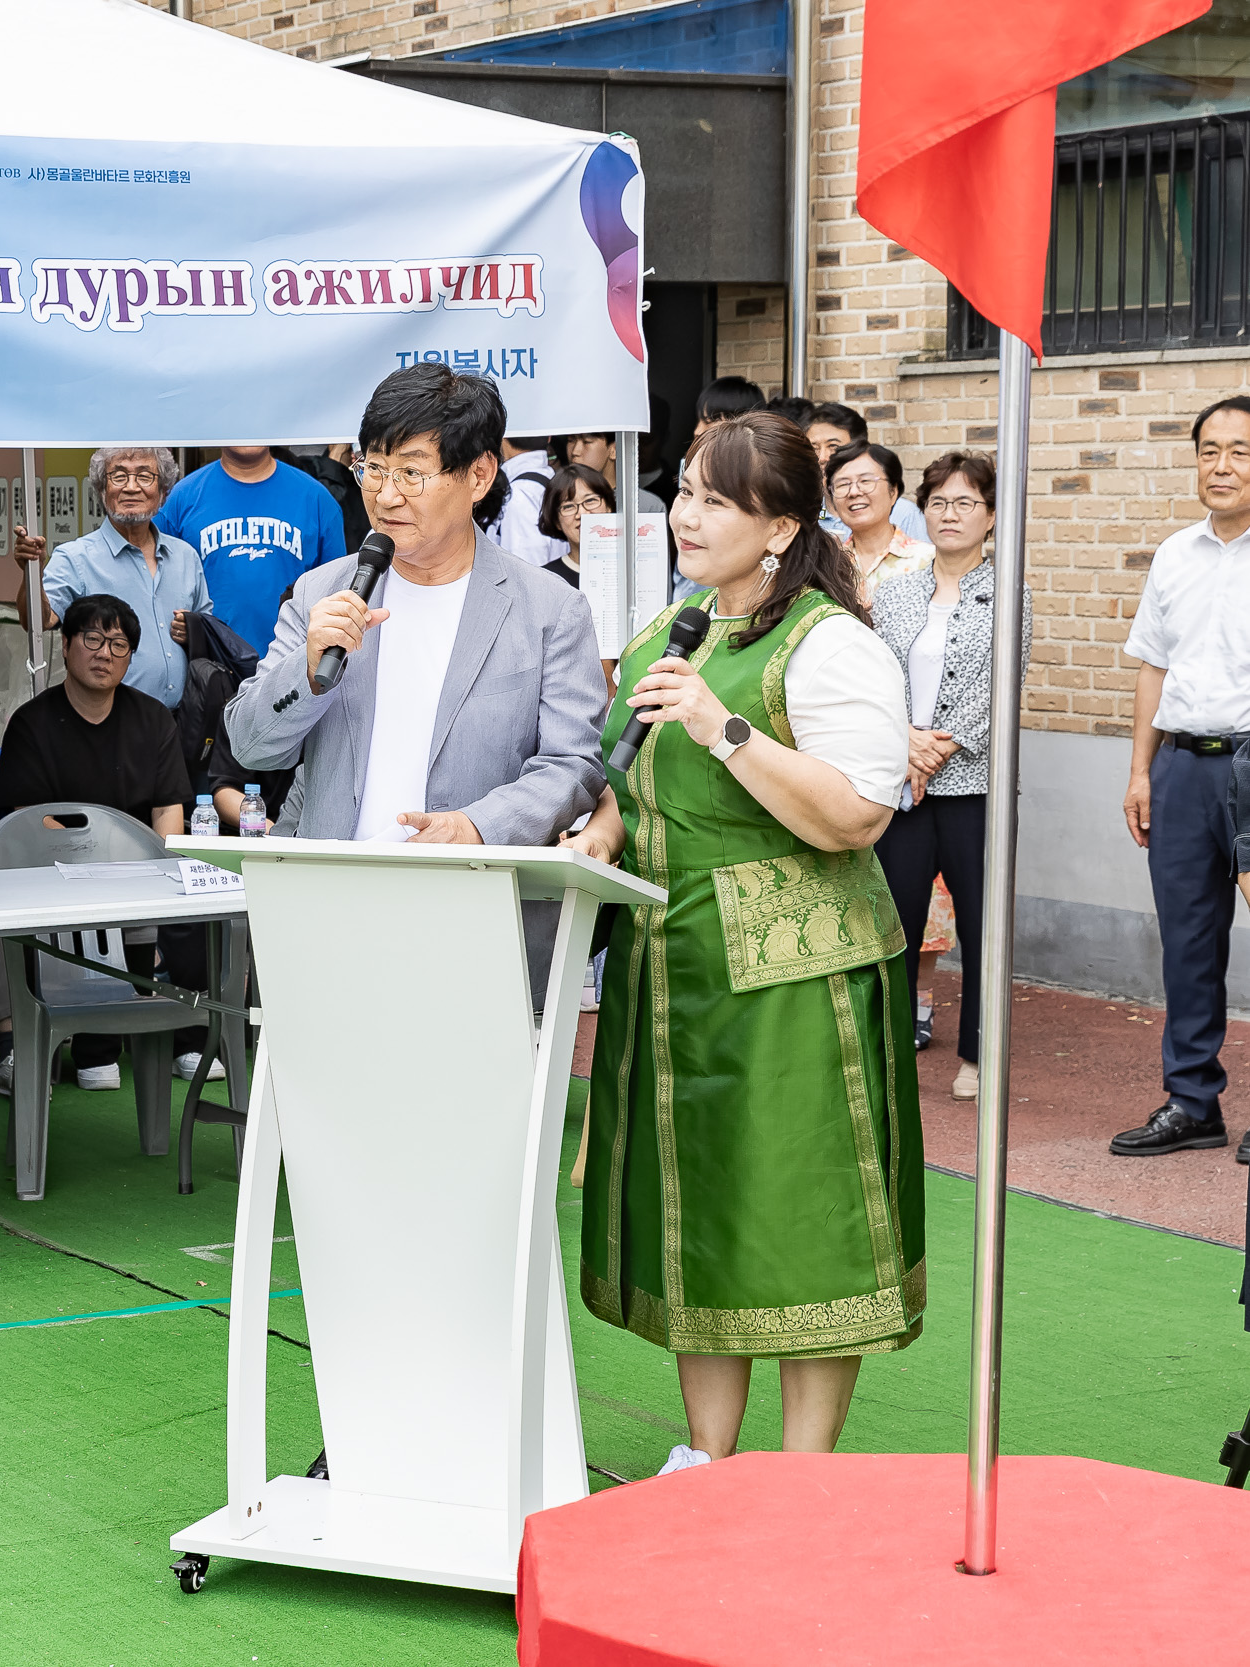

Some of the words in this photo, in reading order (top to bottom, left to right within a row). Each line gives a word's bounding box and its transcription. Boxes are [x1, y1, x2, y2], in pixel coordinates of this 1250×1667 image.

[133, 169, 191, 184] 문화진흥원
[39, 267, 248, 324] дурын
[271, 262, 539, 309] ажилчид
[200, 516, 303, 561] ATHLETICA
[191, 878, 206, 887] 교장
